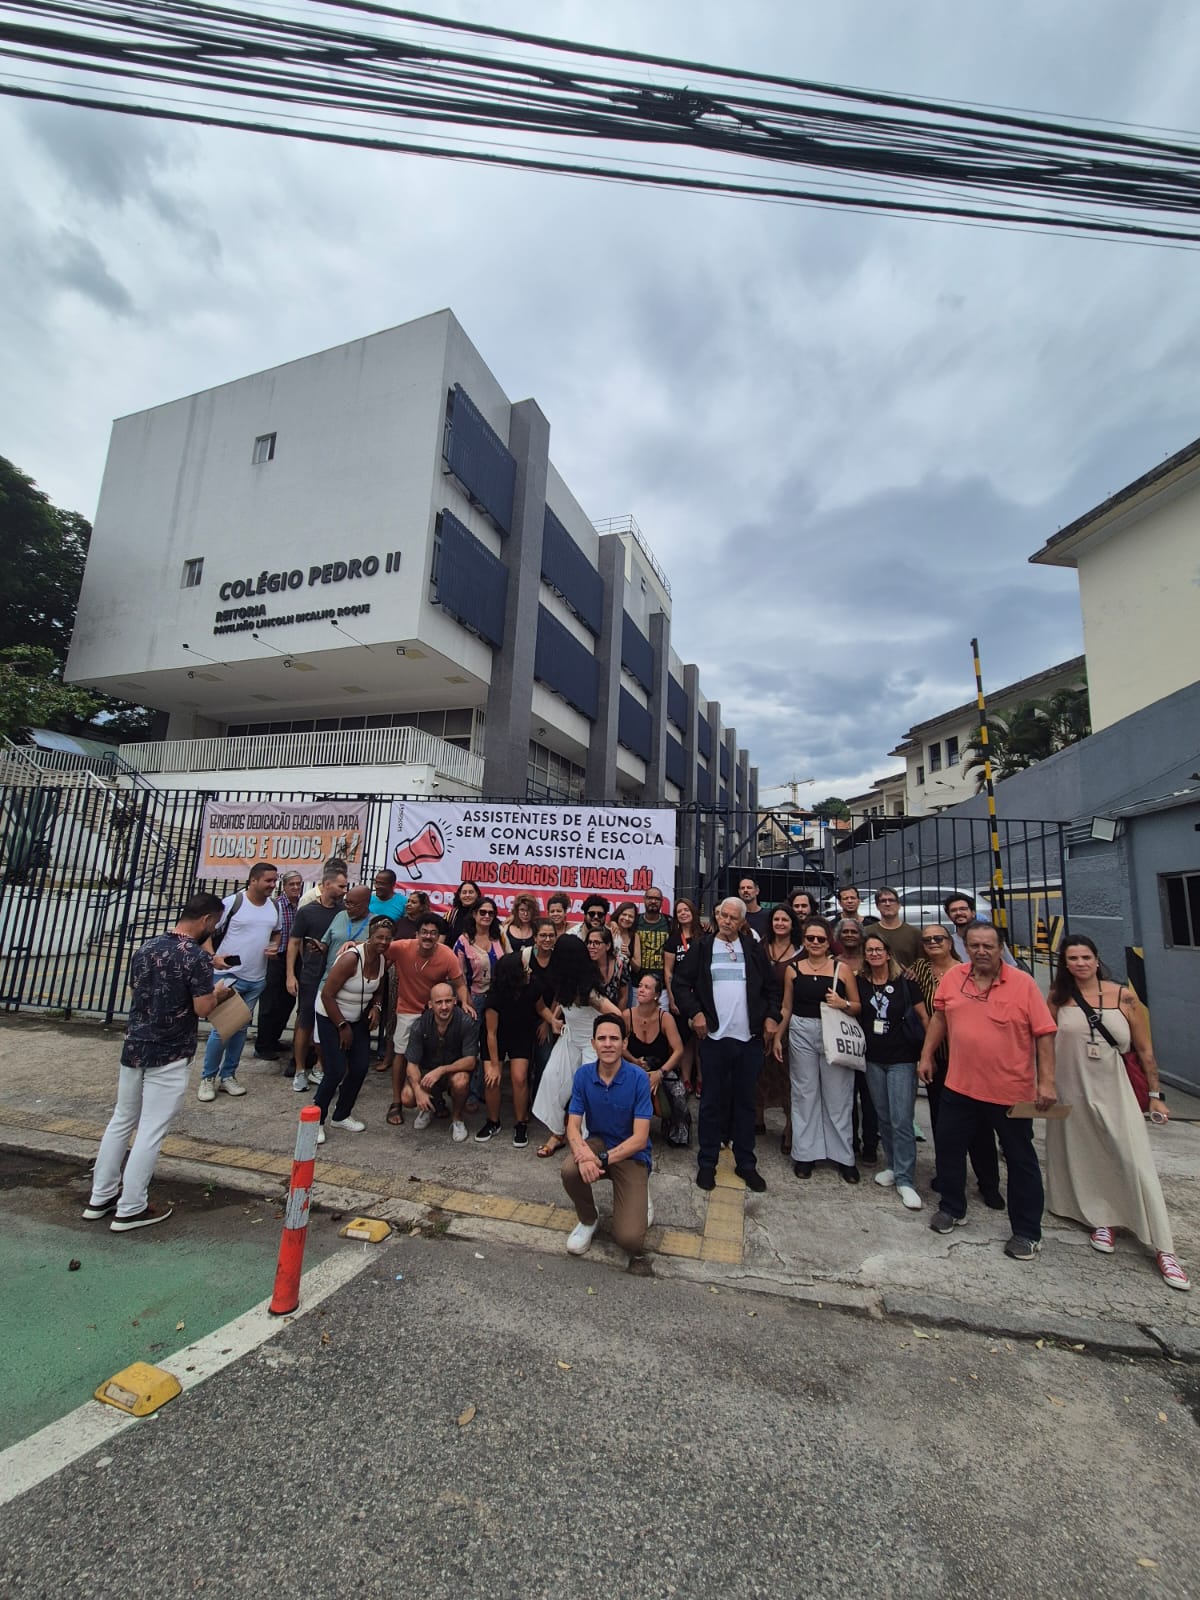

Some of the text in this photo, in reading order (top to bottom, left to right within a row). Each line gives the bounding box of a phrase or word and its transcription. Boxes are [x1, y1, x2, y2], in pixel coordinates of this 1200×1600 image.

[219, 551, 401, 601] COLÉGIO PEDRO II
[215, 604, 267, 623] REITORIA
[256, 614, 295, 629] LINCOLN
[295, 609, 336, 624] BICALHO
[337, 603, 371, 618] ROQUE
[209, 814, 246, 830] EXIGIMOS
[291, 814, 335, 831] EXCLUSIVA
[337, 814, 360, 831] PARA
[462, 810, 653, 829] ASSISTENTES DE ALUNOS
[455, 825, 665, 845] SEM CONCURSO É ESCOLA
[208, 834, 258, 859] TODAS
[258, 835, 270, 859] E
[271, 835, 326, 862] TODOS,
[489, 842, 626, 861] SEM ASSISTÊNCIA
[461, 859, 654, 892] MAIS CÓDIGOS DE VAGAS, JÁ!
[840, 1020, 863, 1039] CIAO
[836, 1037, 867, 1058] BELLA
